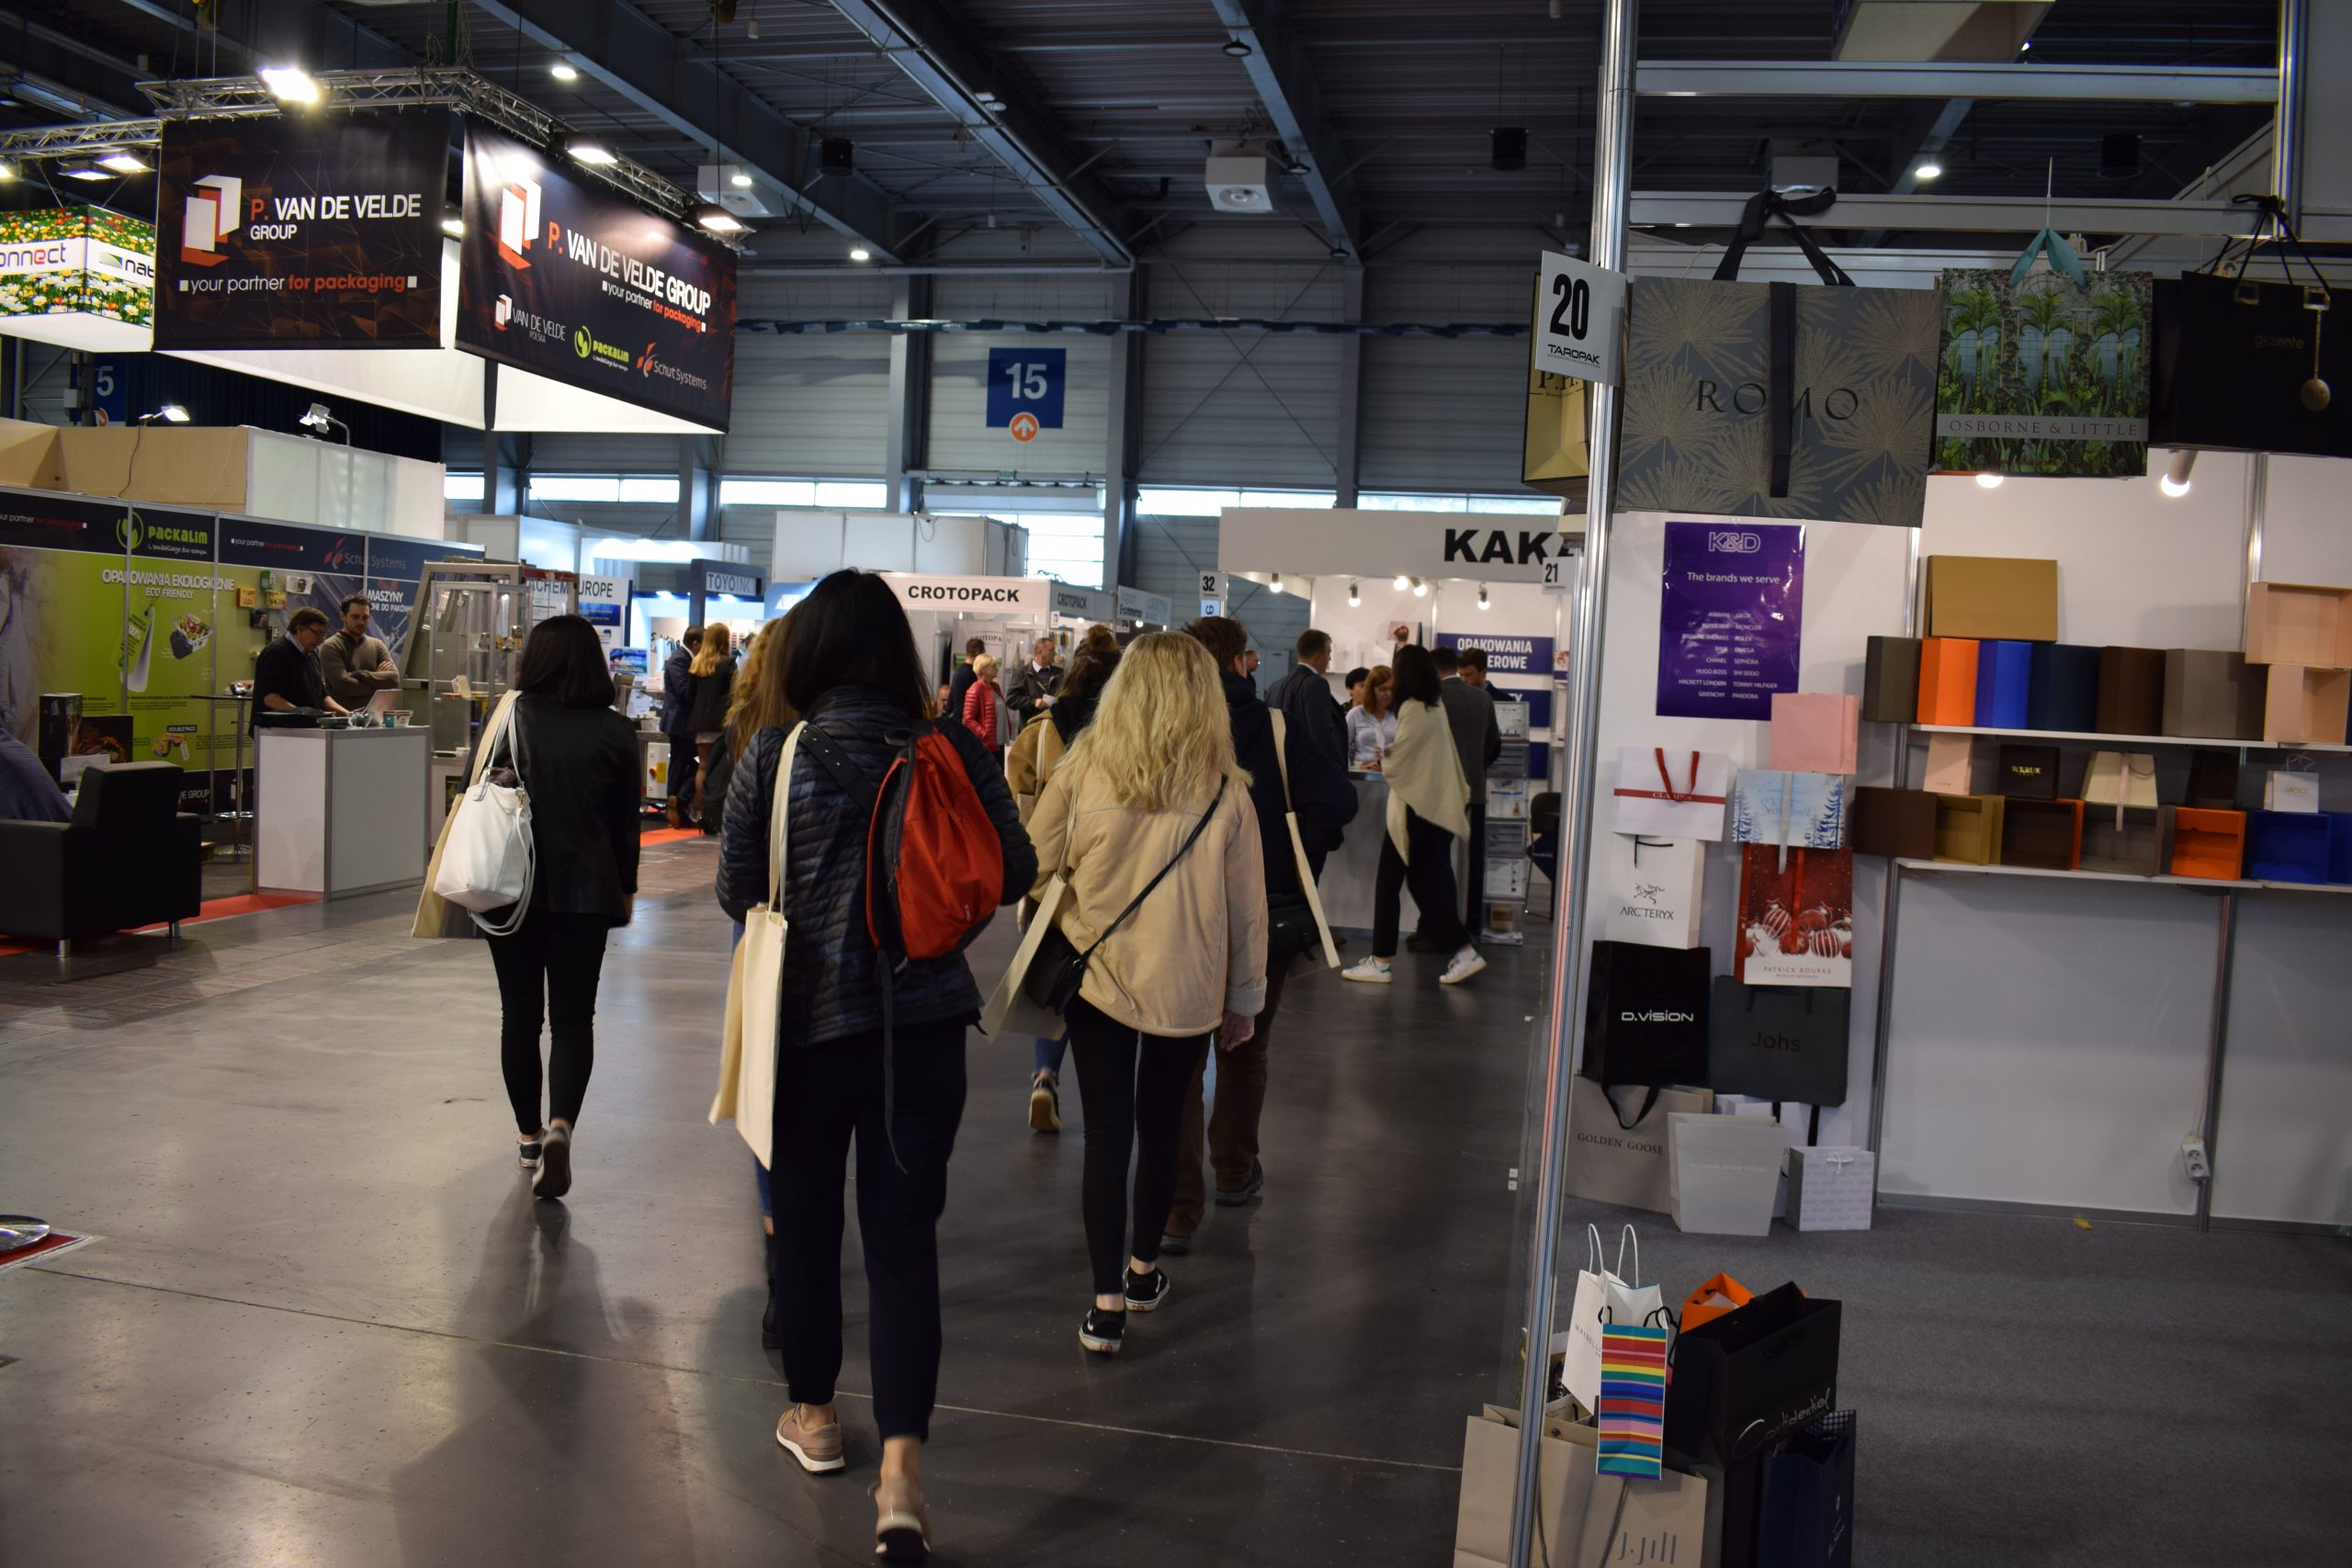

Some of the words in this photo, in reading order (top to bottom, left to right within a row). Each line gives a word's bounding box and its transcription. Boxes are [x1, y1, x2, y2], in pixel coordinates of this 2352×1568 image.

[251, 199, 269, 220] P.
[275, 197, 315, 220] VAN
[321, 196, 349, 220] DE
[354, 194, 422, 219] VELDE
[250, 225, 297, 241] GROUP
[548, 221, 563, 254] P.
[567, 229, 596, 269] VAN
[600, 244, 619, 278] DE
[622, 255, 664, 299] VELDE
[666, 276, 711, 316] GROUP
[191, 277, 223, 294] your
[227, 276, 285, 294] partner
[288, 275, 309, 290] for
[314, 273, 405, 293] packaging
[607, 282, 625, 298] your
[625, 290, 652, 310] partner
[652, 299, 663, 314] for
[663, 305, 701, 333] packaging
[1550, 273, 1589, 341] 20
[513, 307, 528, 328] VAN
[530, 313, 542, 332] DE
[543, 318, 566, 342] VELDE
[1547, 344, 1600, 365] TAROPAK
[653, 360, 675, 382] Schut
[676, 367, 707, 390] Systems
[1006, 363, 1047, 400] 15
[1949, 420, 2041, 434] OSBORNE
[2050, 423, 2062, 434] &
[2071, 423, 2138, 436] LITTLE
[1709, 532, 1761, 553] K&D
[345, 552, 365, 566] Schu
[371, 555, 407, 570] Systems
[1544, 563, 1558, 582] 21
[1687, 571, 1704, 581] The
[1706, 573, 1738, 583] brands
[1755, 576, 1781, 584] serve
[708, 573, 734, 591] TOYO
[1203, 576, 1215, 592] 32
[146, 588, 160, 596] ECO
[162, 589, 194, 599] FRIENDLY
[368, 590, 403, 603] MASZYNY
[908, 585, 1020, 603] CROTOPACK
[1057, 592, 1087, 610] CROTOPACK
[1457, 637, 1532, 654] OPAKOWANIA
[1734, 646, 1755, 654] OMEGA
[187, 789, 209, 799] GROUP
[1764, 965, 1796, 975] PATRICK
[1799, 966, 1831, 976] BOURKE
[1577, 1132, 1623, 1147] GOLDEN
[1627, 1141, 1664, 1155] GOOSE
